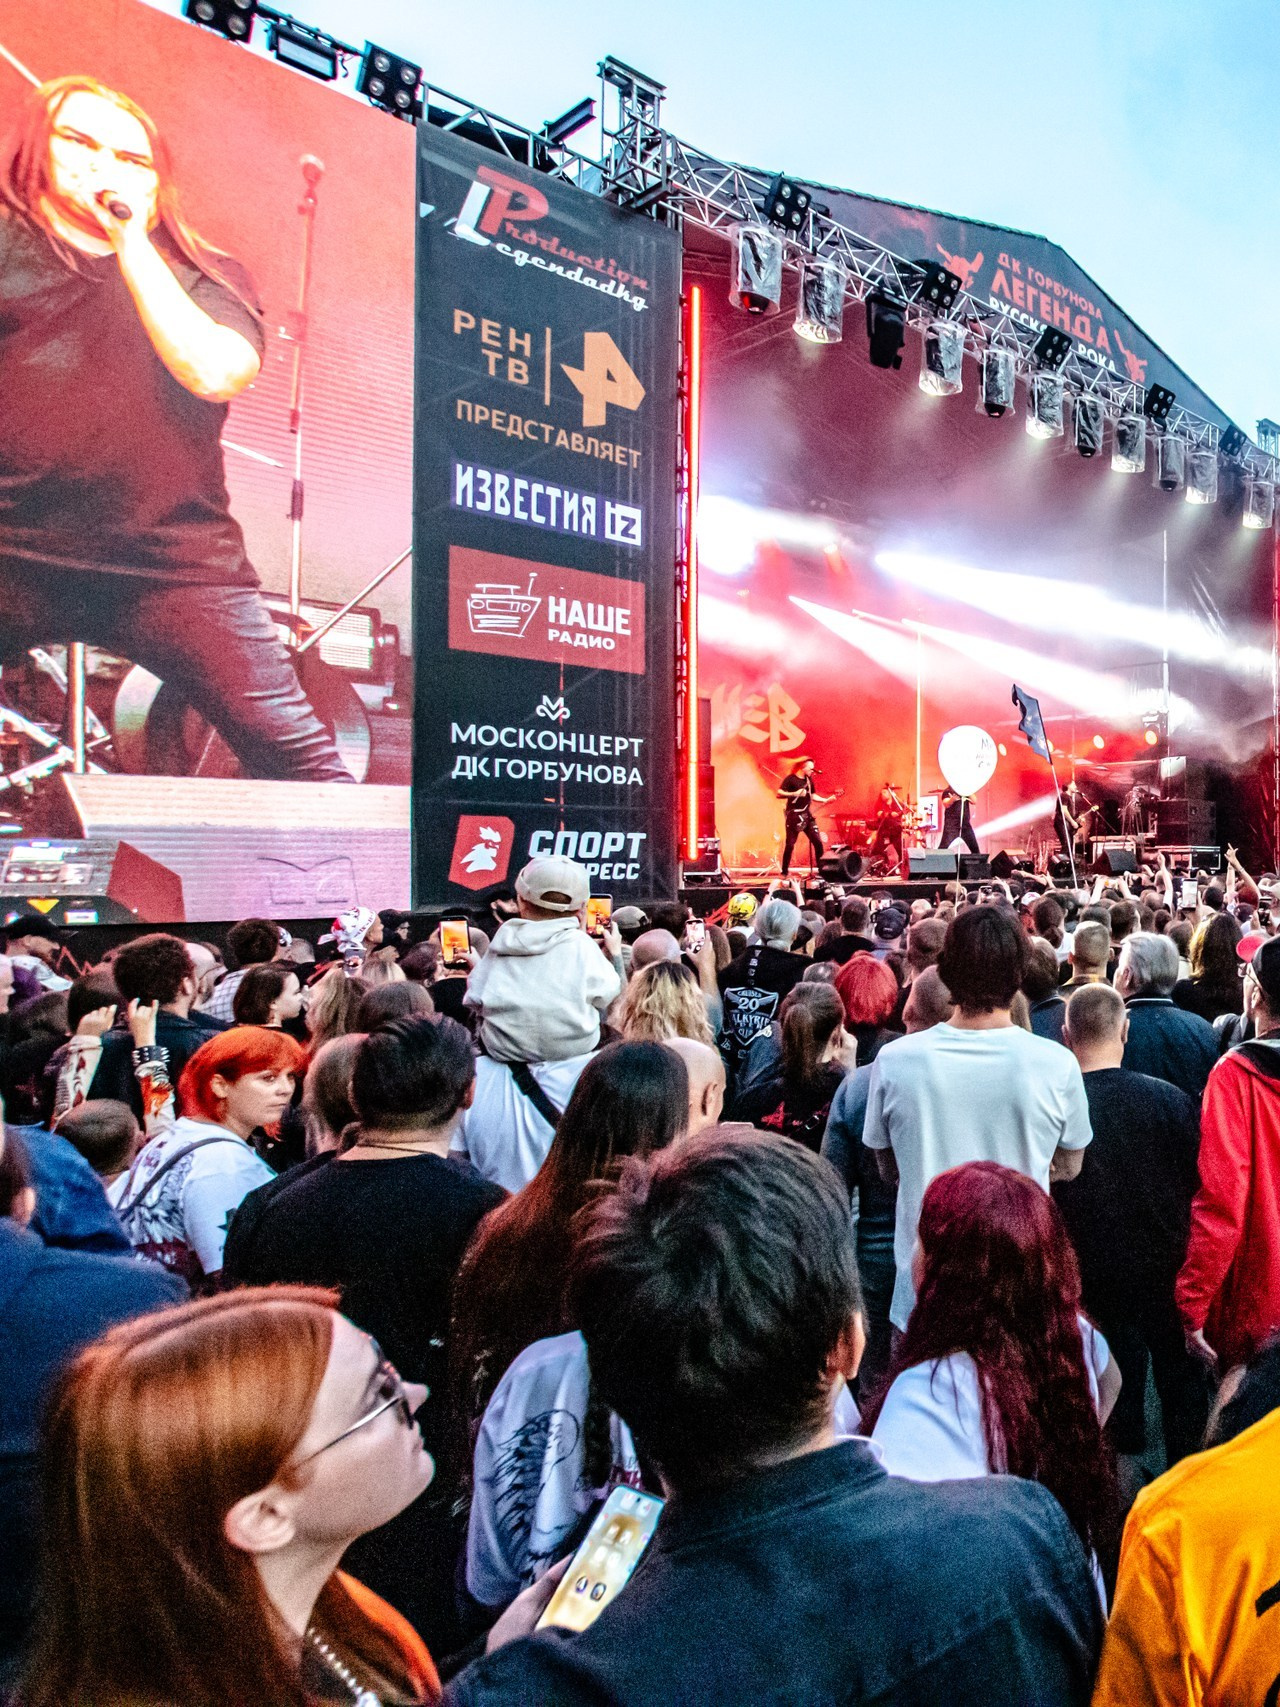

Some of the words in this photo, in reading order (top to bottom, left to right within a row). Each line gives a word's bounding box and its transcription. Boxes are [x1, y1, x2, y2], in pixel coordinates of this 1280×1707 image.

[477, 165, 649, 290] Production
[998, 252, 1022, 275] ДК
[1027, 267, 1104, 321] ГОРБУНОВА
[991, 268, 1112, 355] ЛЕГЕНДА
[454, 308, 531, 358] РЕН
[989, 293, 1047, 334] РУССК
[1078, 340, 1117, 372] РОКА
[481, 348, 530, 385] ТВ
[457, 399, 642, 468] ПРЕДСТАВЛЯЕТ
[456, 463, 596, 536] ИЗВЕСТИЯ
[548, 596, 631, 636] НАШЕ
[548, 629, 616, 651] РАДИО
[451, 722, 644, 757] МОСКОНЦЕРТ
[451, 755, 491, 780] ДК
[494, 758, 644, 786] ГОРБУНОВА
[528, 830, 647, 859] СПОРТ
[587, 863, 640, 880] РЕСС
[738, 997, 760, 1010] 20
